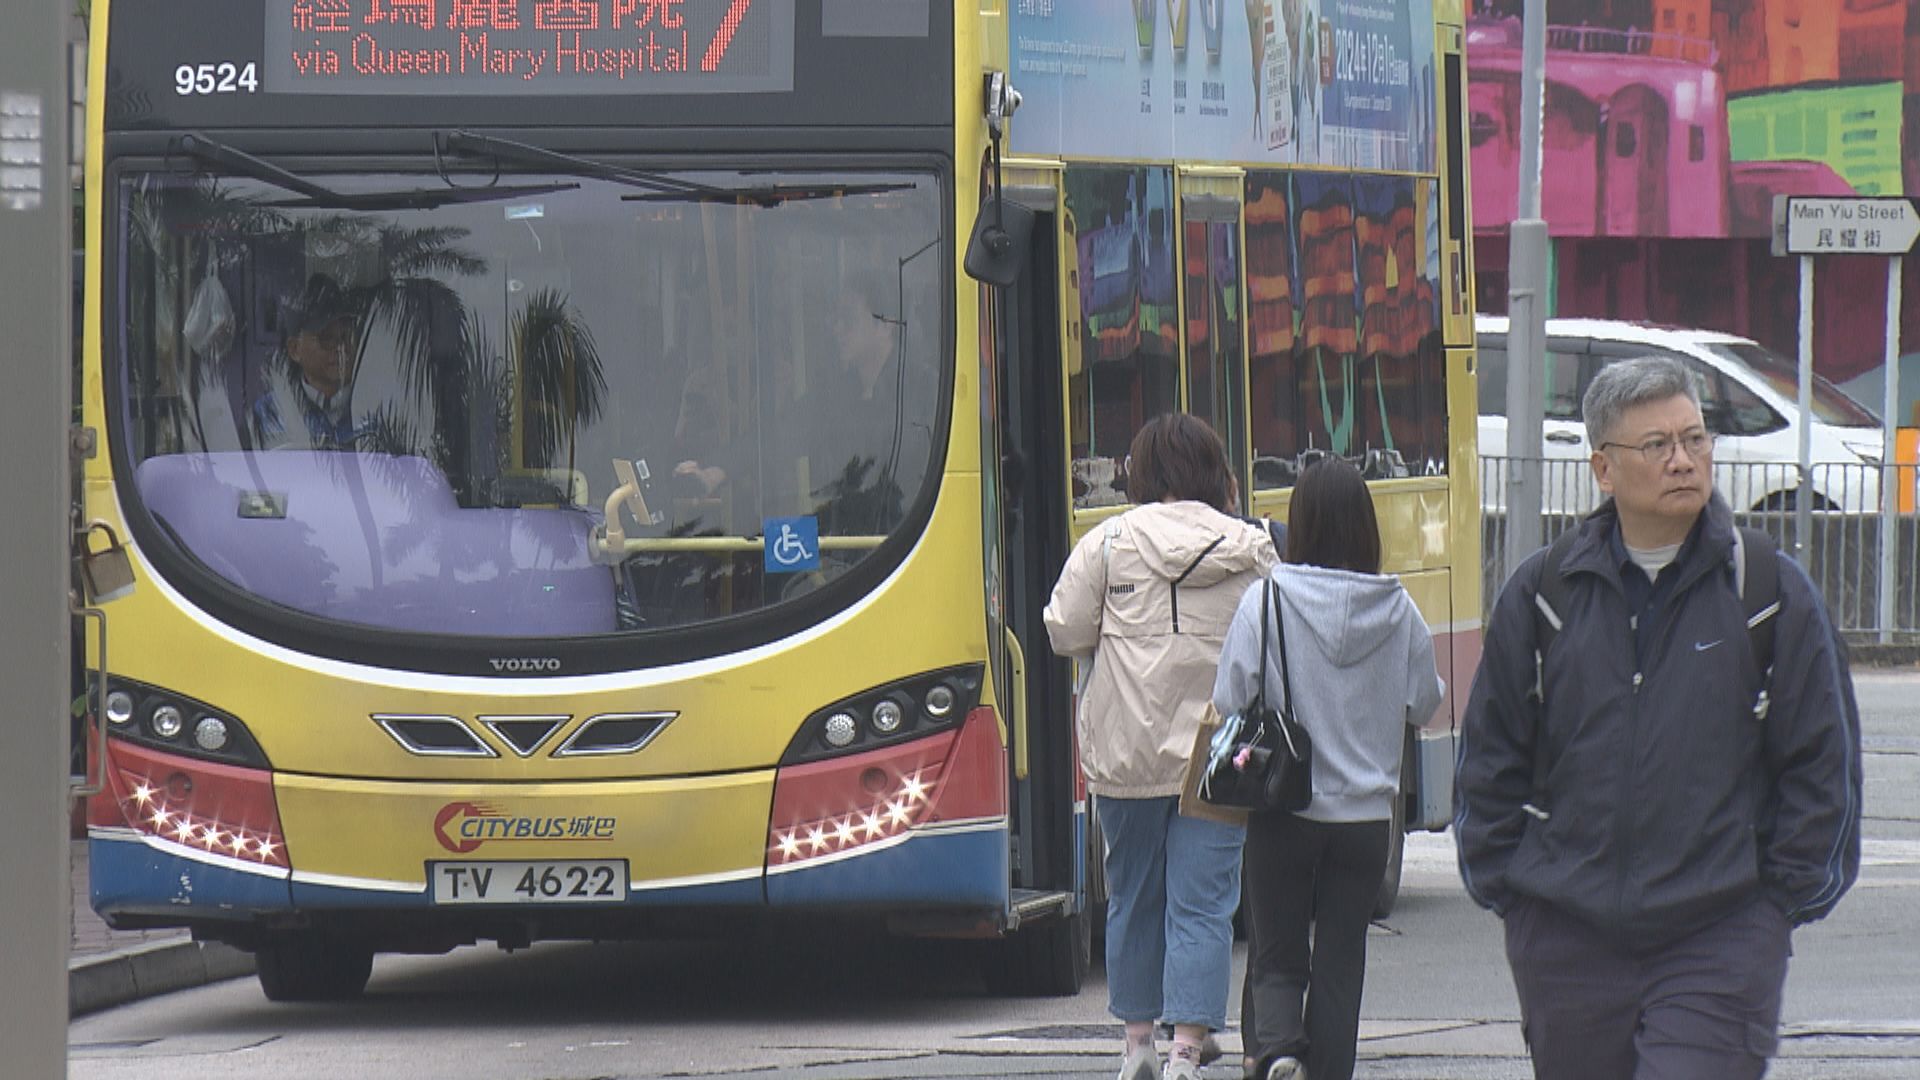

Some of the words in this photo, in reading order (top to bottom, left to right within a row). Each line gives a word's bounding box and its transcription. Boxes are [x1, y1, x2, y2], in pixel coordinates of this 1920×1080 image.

[292, 38, 340, 75] via
[351, 32, 451, 74] Queen
[459, 31, 547, 80] Mary
[556, 29, 687, 80] Hospital
[175, 61, 258, 96] 9524
[1793, 203, 1824, 219] Man
[1829, 203, 1853, 219] Yiu
[1857, 203, 1905, 220] Street
[1109, 583, 1135, 595] PUMA
[489, 658, 561, 672] VOLVO
[460, 817, 567, 838] CITYBUS
[568, 815, 616, 838] 城巴
[443, 867, 493, 899] TV
[515, 865, 616, 898] 4622
